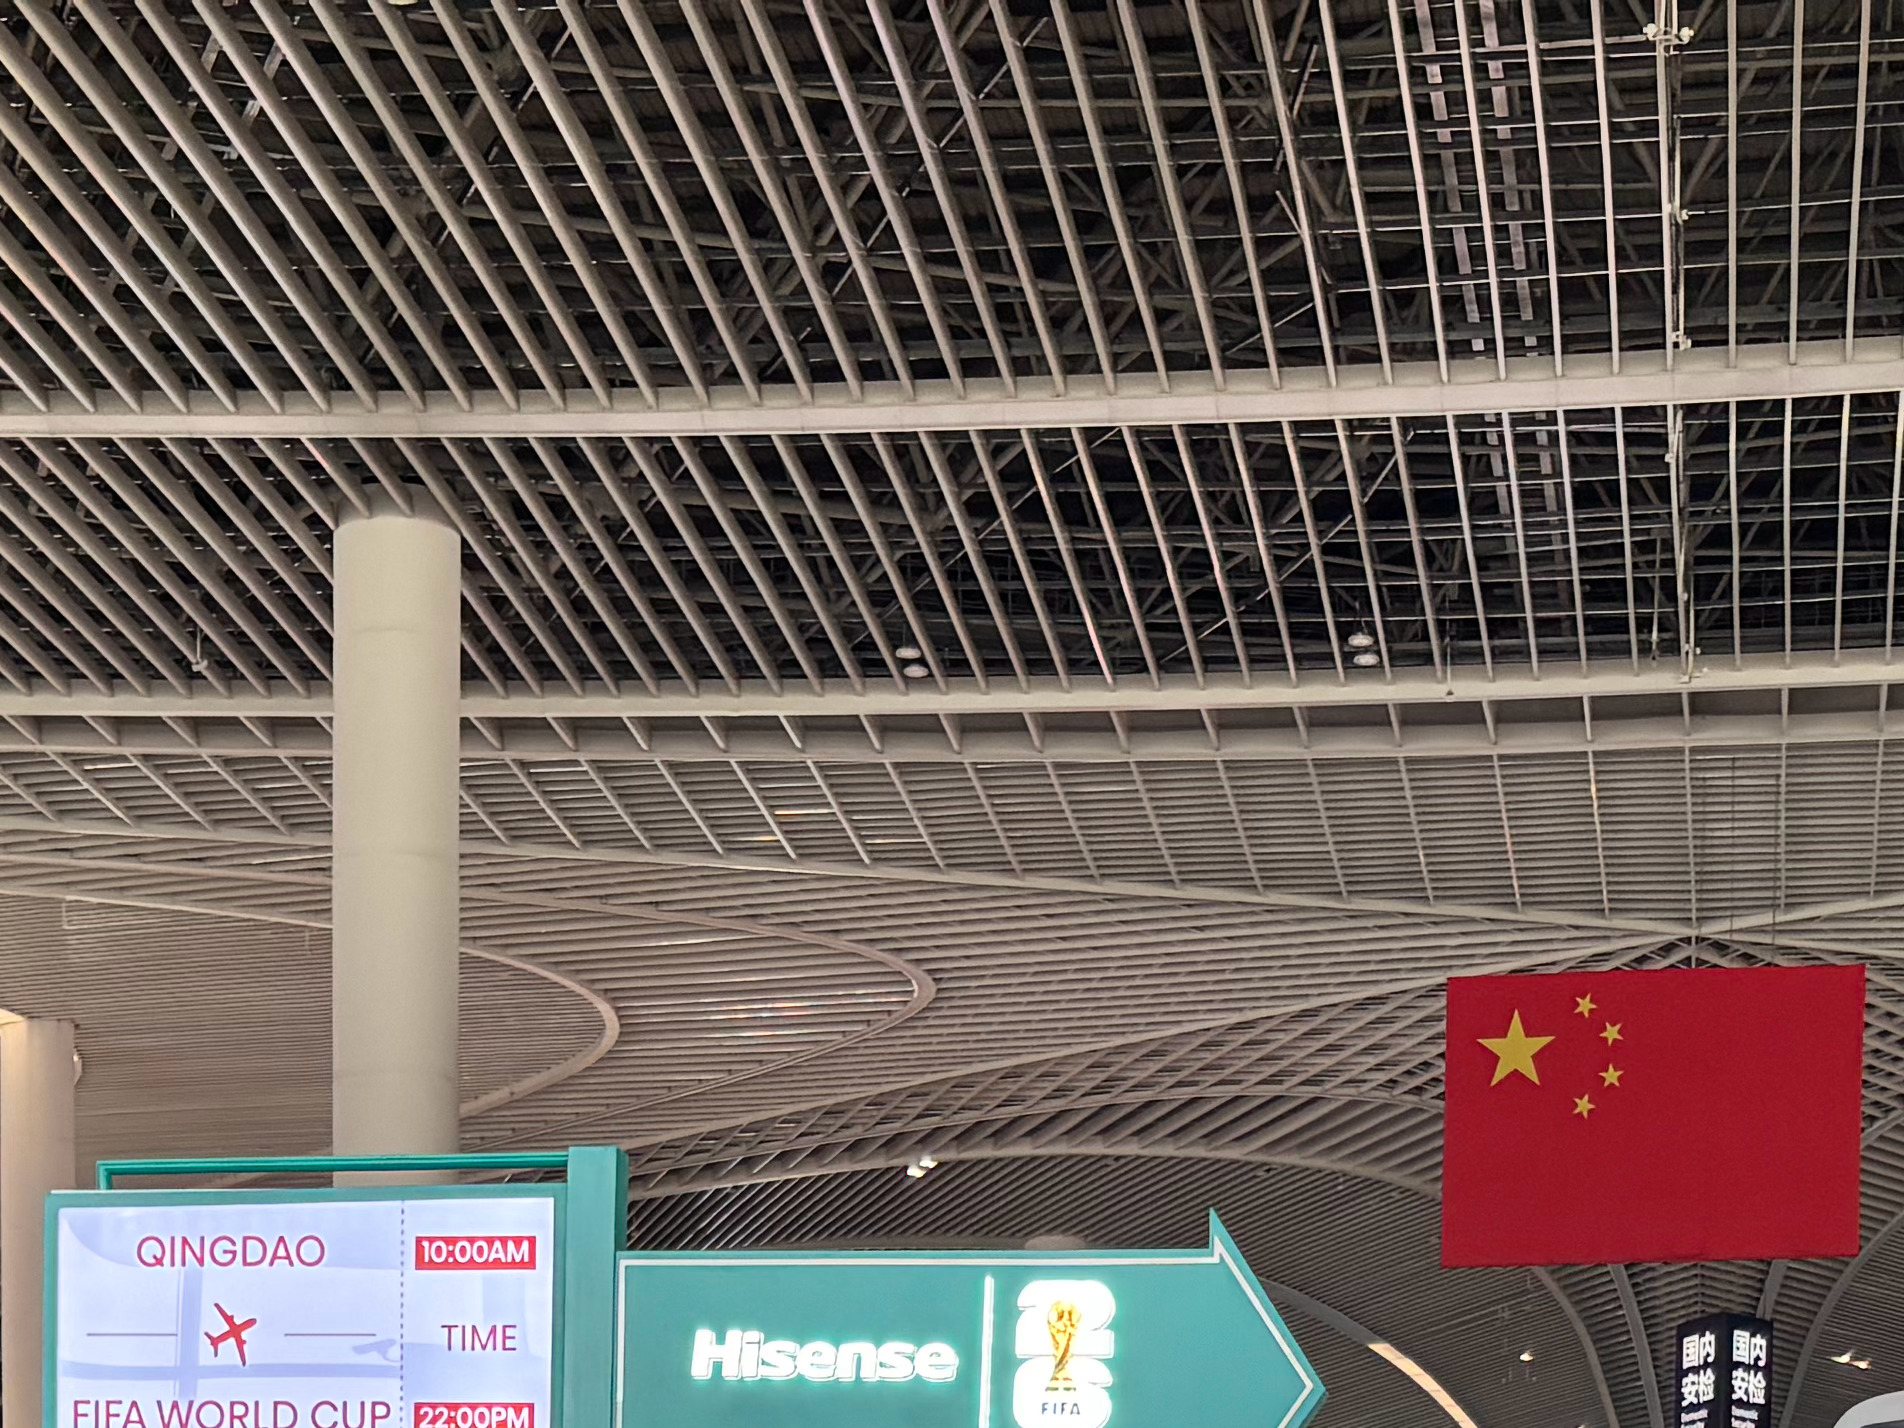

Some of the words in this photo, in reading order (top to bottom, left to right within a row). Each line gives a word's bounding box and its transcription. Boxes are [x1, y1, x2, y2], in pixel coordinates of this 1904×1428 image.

[137, 1234, 326, 1268] QINGDAO
[421, 1238, 530, 1265] 10:00AM
[441, 1324, 517, 1352] TIME
[690, 1329, 958, 1382] Hisense
[1682, 1330, 1716, 1370] 国内
[1732, 1329, 1767, 1367] 国内
[1681, 1367, 1715, 1406] 安检
[1731, 1368, 1766, 1405] 安检
[1040, 1402, 1081, 1416] FIFA
